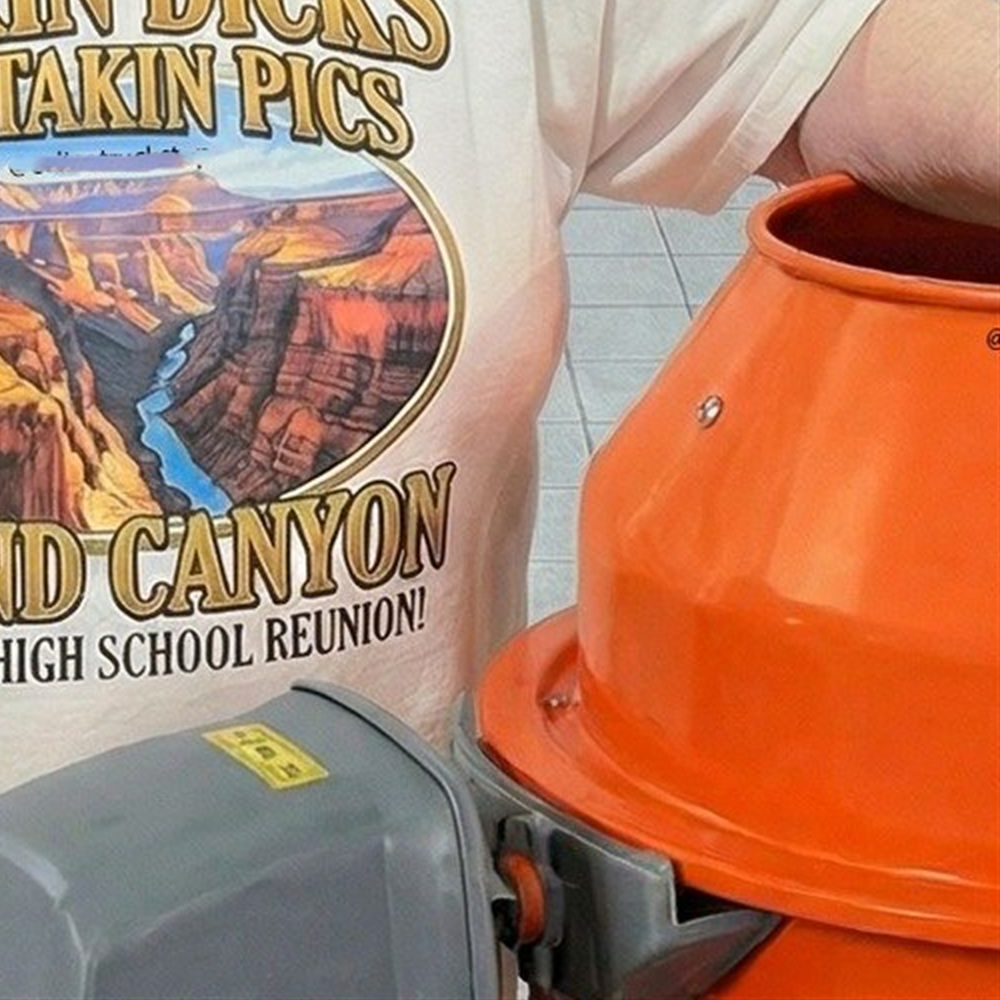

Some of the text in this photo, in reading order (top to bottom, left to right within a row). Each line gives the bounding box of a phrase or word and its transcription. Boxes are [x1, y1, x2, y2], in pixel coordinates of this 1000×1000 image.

[236, 46, 415, 159] PICS
[108, 462, 457, 620] CANYON
[99, 623, 253, 680] SCHOOL
[264, 587, 427, 664] REUNION!
